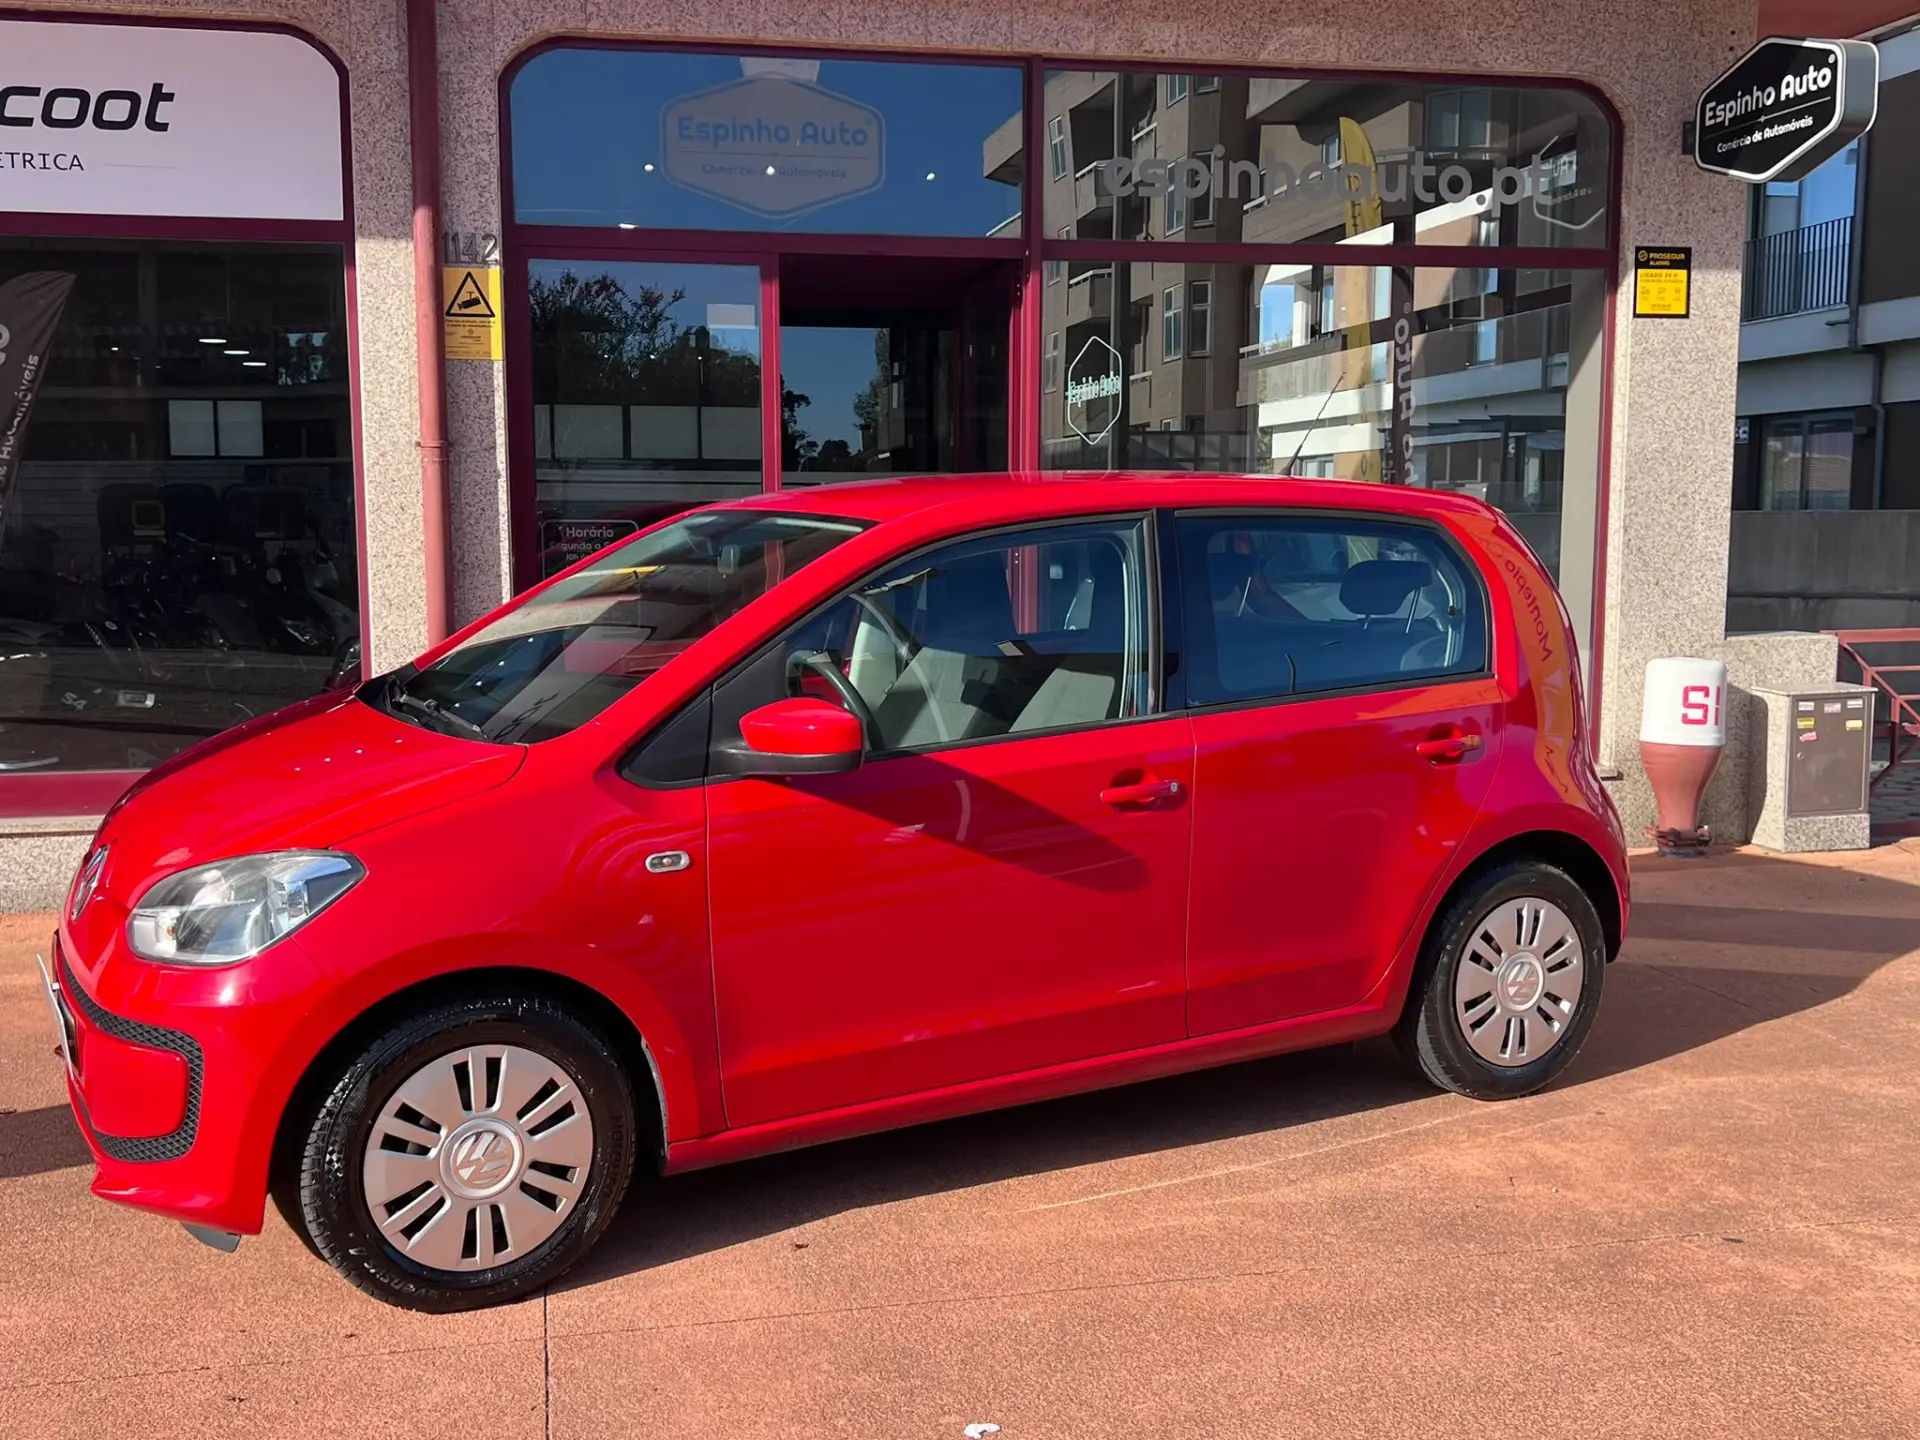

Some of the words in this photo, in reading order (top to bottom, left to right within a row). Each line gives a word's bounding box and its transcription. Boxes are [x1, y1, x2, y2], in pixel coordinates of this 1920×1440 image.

[0, 82, 175, 132] coot
[1705, 85, 1776, 127] Espinho
[1780, 65, 1832, 101] Auto
[677, 116, 791, 148] Espinho
[800, 120, 868, 147] Auto
[1752, 130, 1763, 143] de
[1763, 115, 1814, 139] Automóveis
[0, 152, 85, 172] TRICA
[1103, 143, 1552, 218] espinhoauto.pt
[1649, 252, 1686, 260] PROSEGUR
[566, 526, 614, 538] Horário
[549, 541, 592, 552] Sgunda
